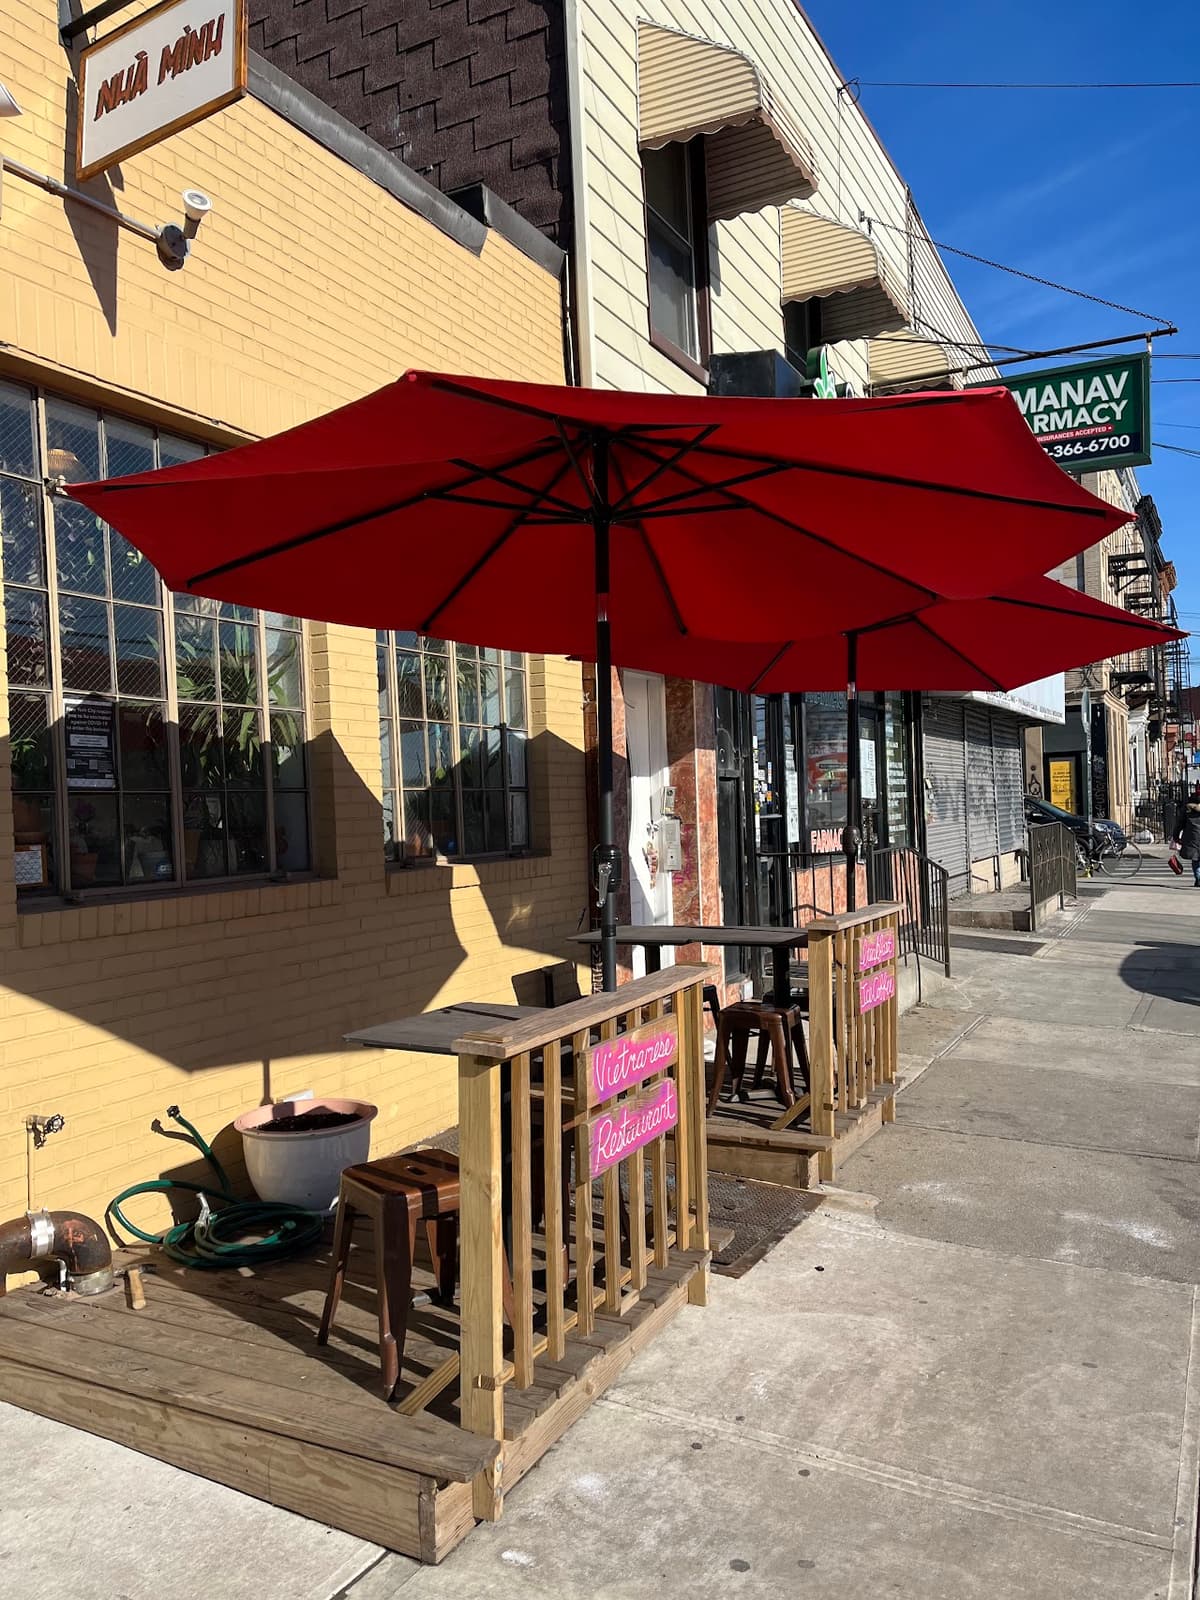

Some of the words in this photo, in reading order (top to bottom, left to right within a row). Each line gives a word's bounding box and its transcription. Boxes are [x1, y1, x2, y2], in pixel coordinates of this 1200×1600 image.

[157, 14, 224, 85] MÌNH
[1024, 400, 1129, 434] RMACY
[1075, 426, 1107, 437] ACCEPTED
[595, 1037, 674, 1092] Vietnamese
[595, 1082, 676, 1173] Restaurant
